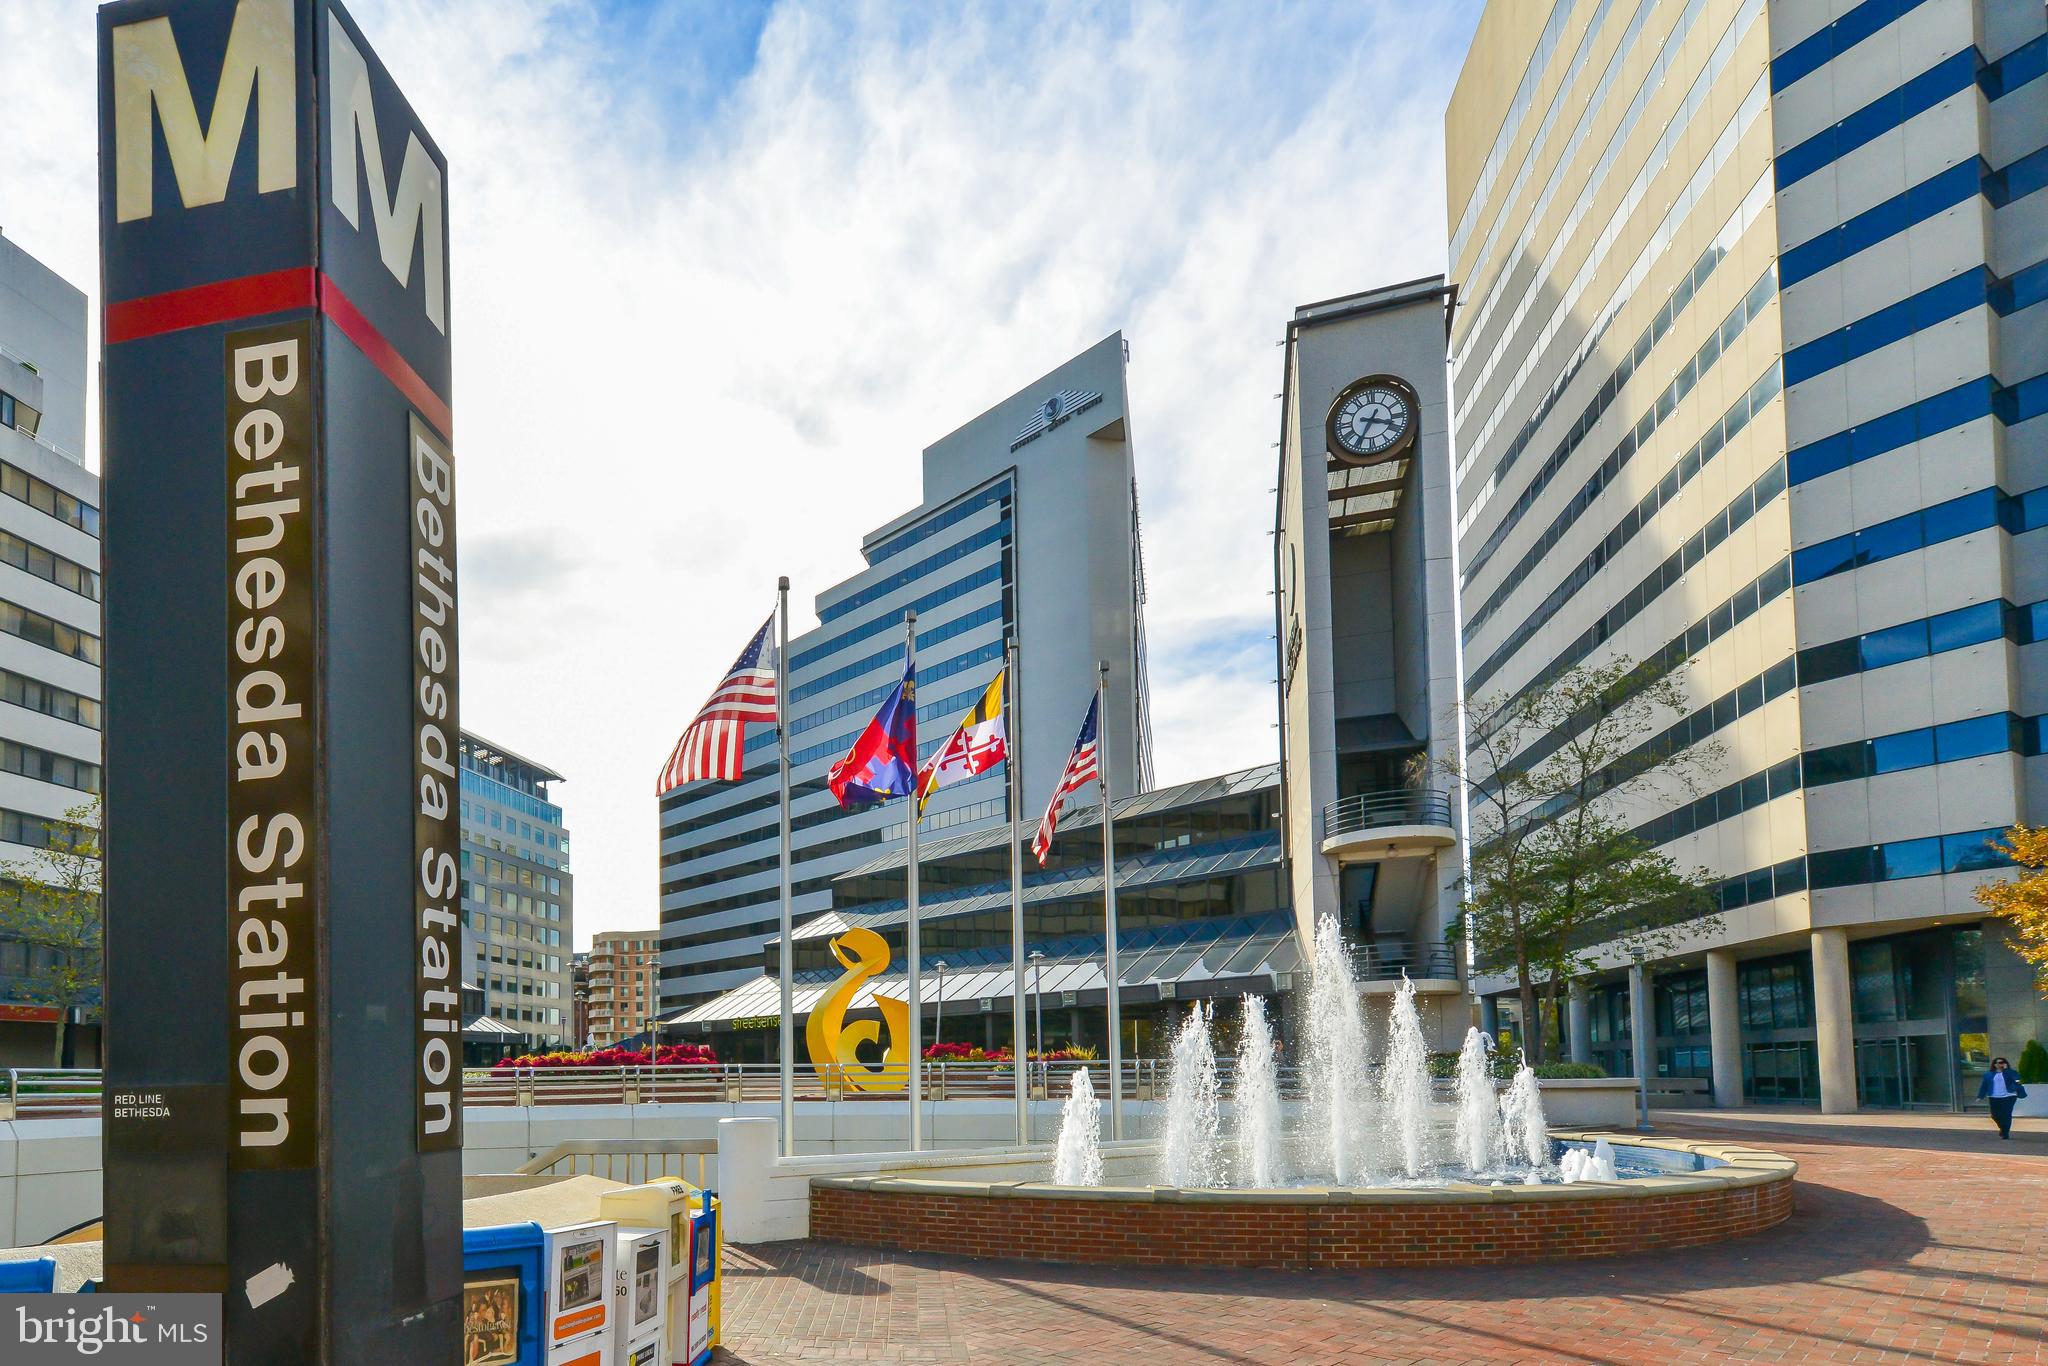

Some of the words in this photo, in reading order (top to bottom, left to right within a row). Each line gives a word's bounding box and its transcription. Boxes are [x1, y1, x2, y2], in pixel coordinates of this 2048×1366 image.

[113, 0, 298, 224] M
[328, 6, 446, 337] M
[234, 338, 301, 782] Bethesda
[416, 434, 456, 820] Bethesda
[114, 1094, 137, 1105] RED
[138, 1094, 162, 1104] LINE
[114, 1107, 171, 1118] BETHESDA
[237, 812, 303, 1147] Station
[421, 847, 457, 1135] Station
